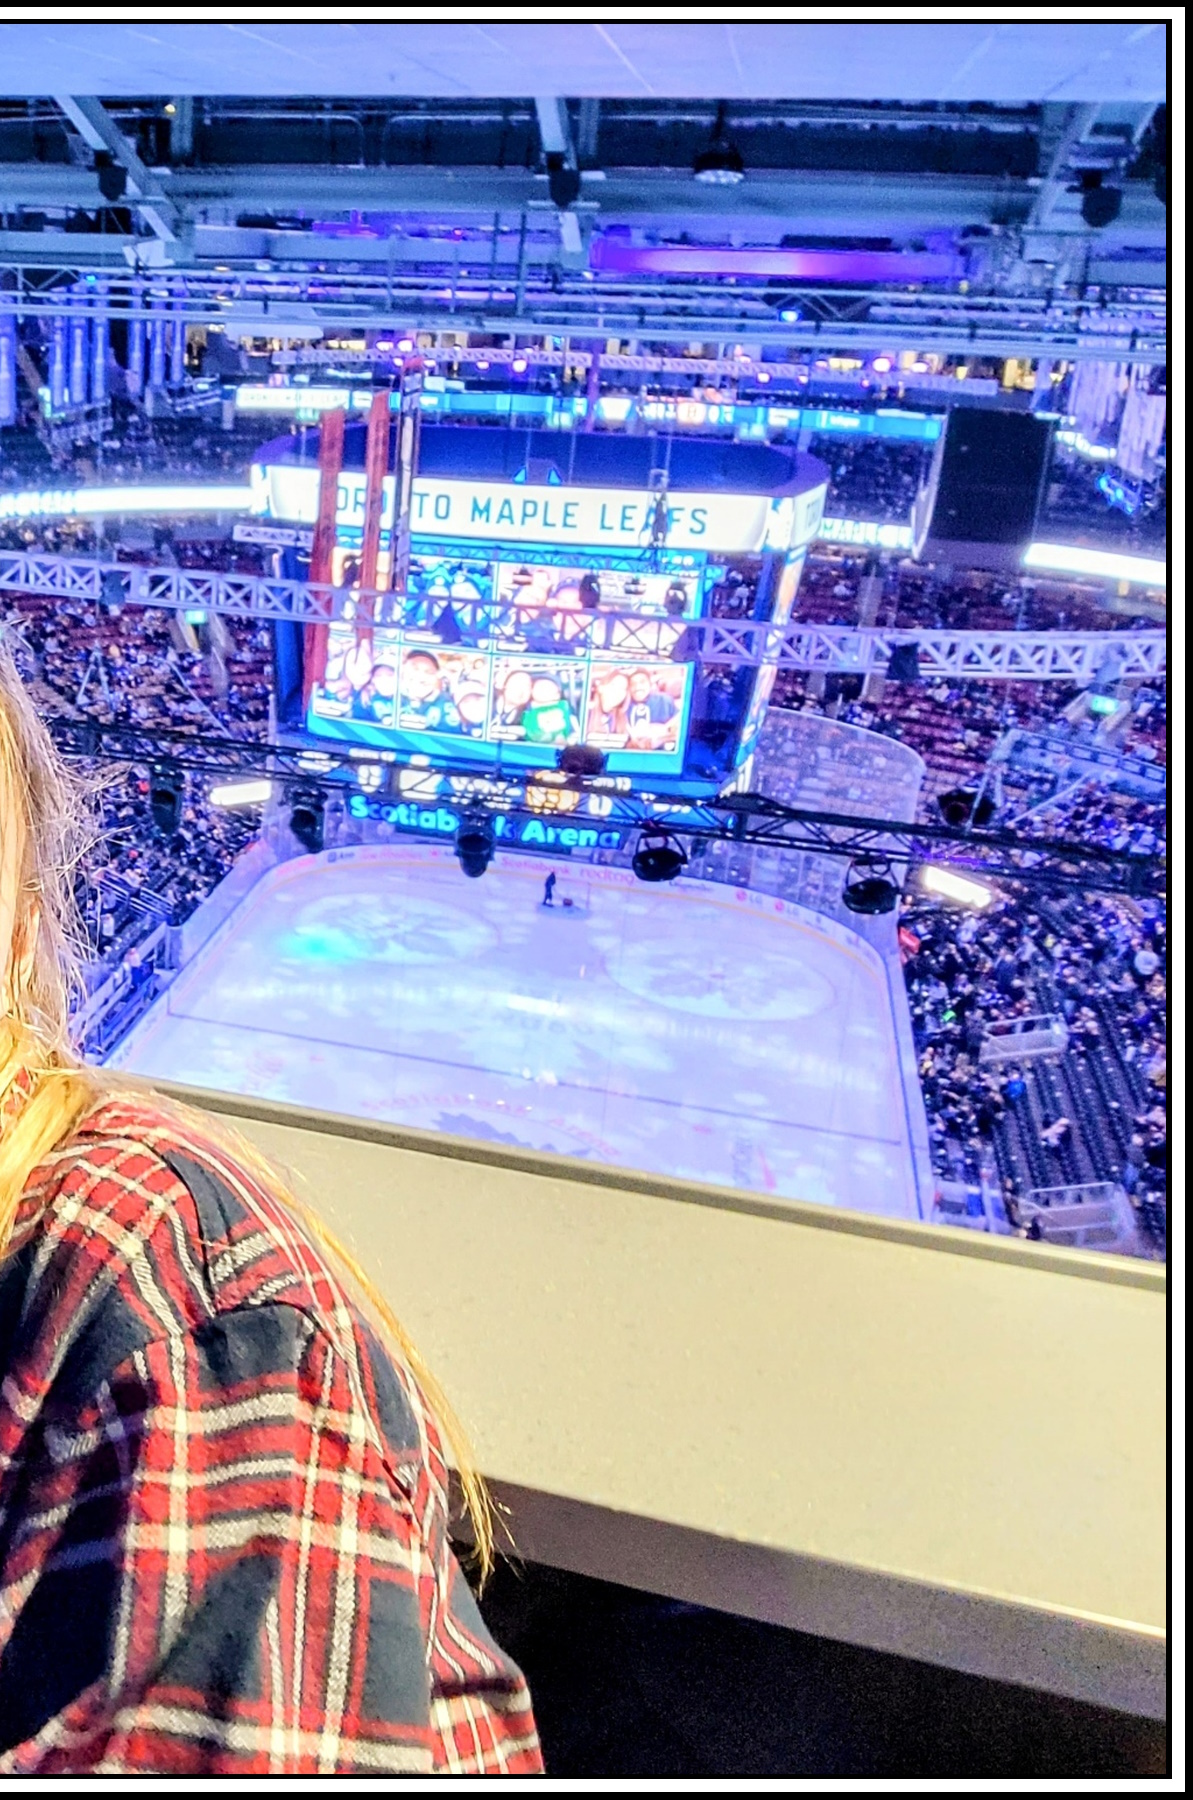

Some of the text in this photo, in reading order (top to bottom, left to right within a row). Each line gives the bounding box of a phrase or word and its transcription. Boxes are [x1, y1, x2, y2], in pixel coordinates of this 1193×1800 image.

[470, 496, 580, 529] MAPLE
[349, 794, 621, 849] Scotiabk Arena
